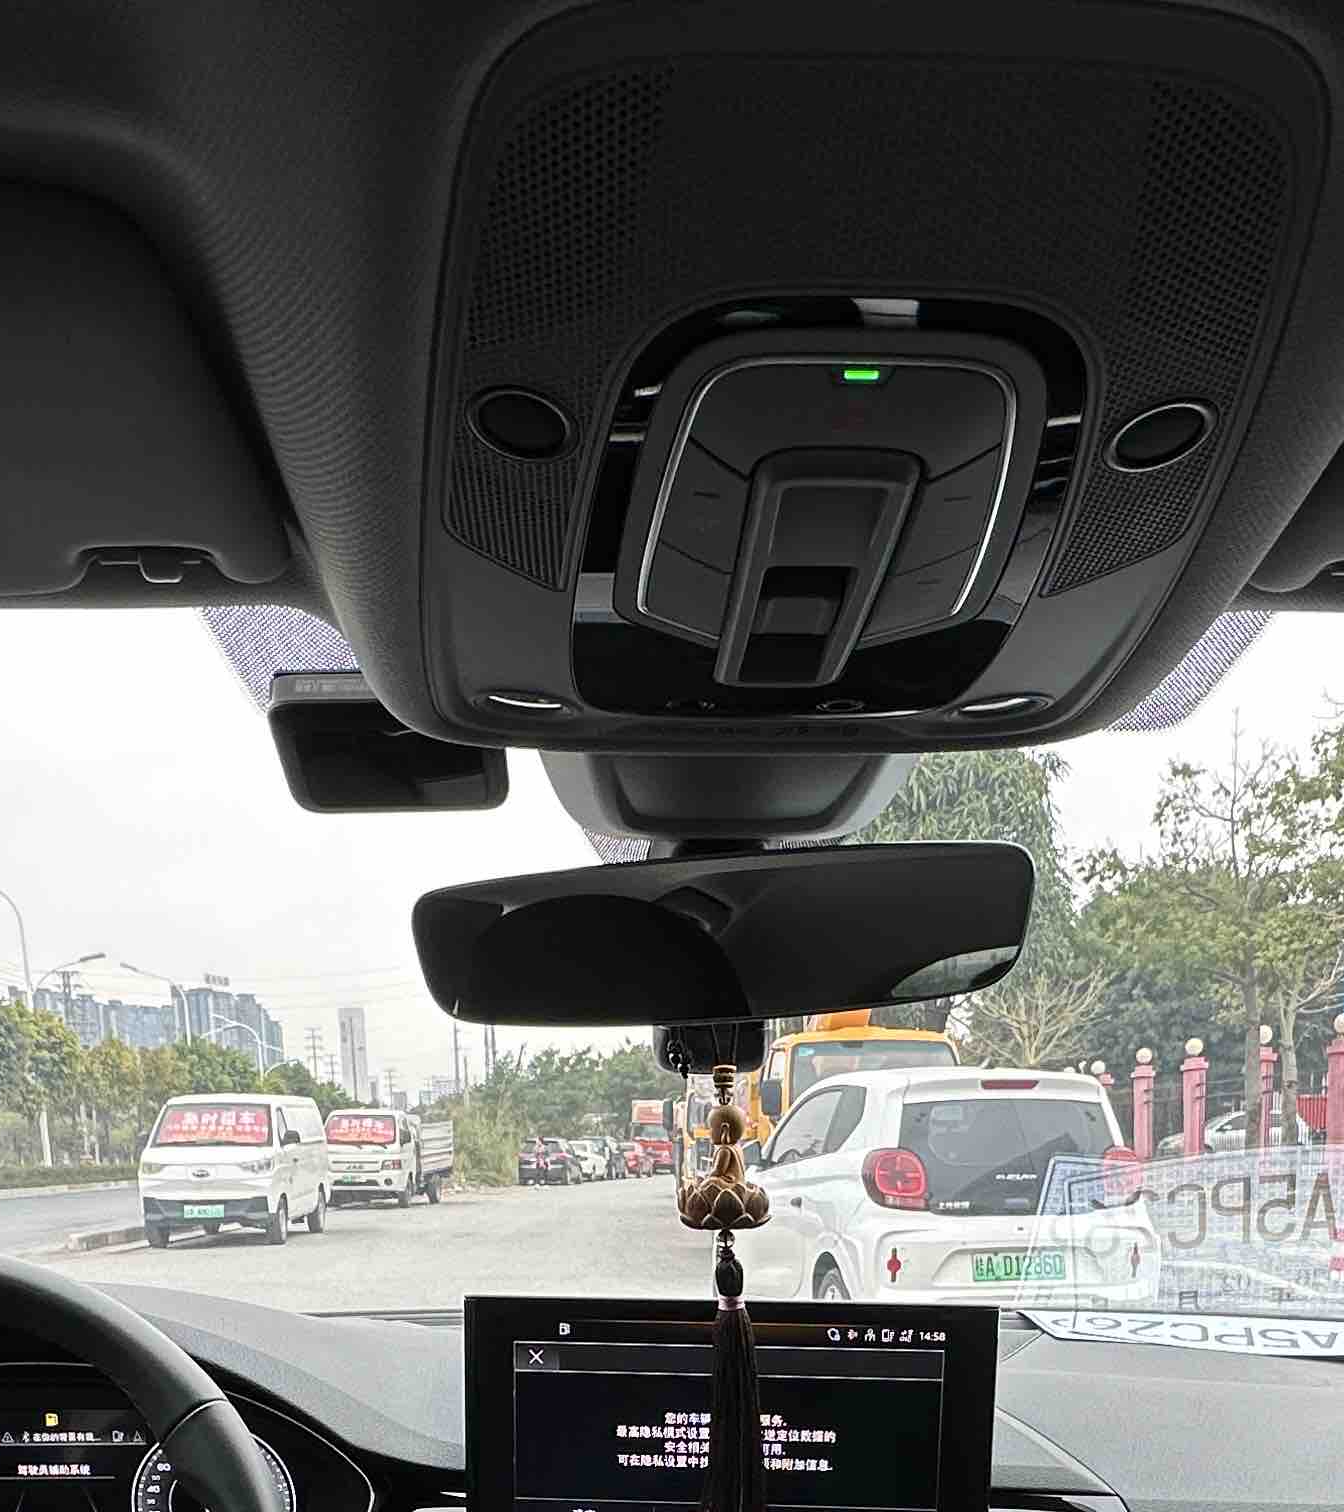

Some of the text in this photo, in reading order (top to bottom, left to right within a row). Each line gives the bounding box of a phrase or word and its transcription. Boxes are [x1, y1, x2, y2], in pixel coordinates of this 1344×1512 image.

[919, 1331, 946, 1341] 14:58
[17, 1464, 91, 1476] 驾驶员辅助系统
